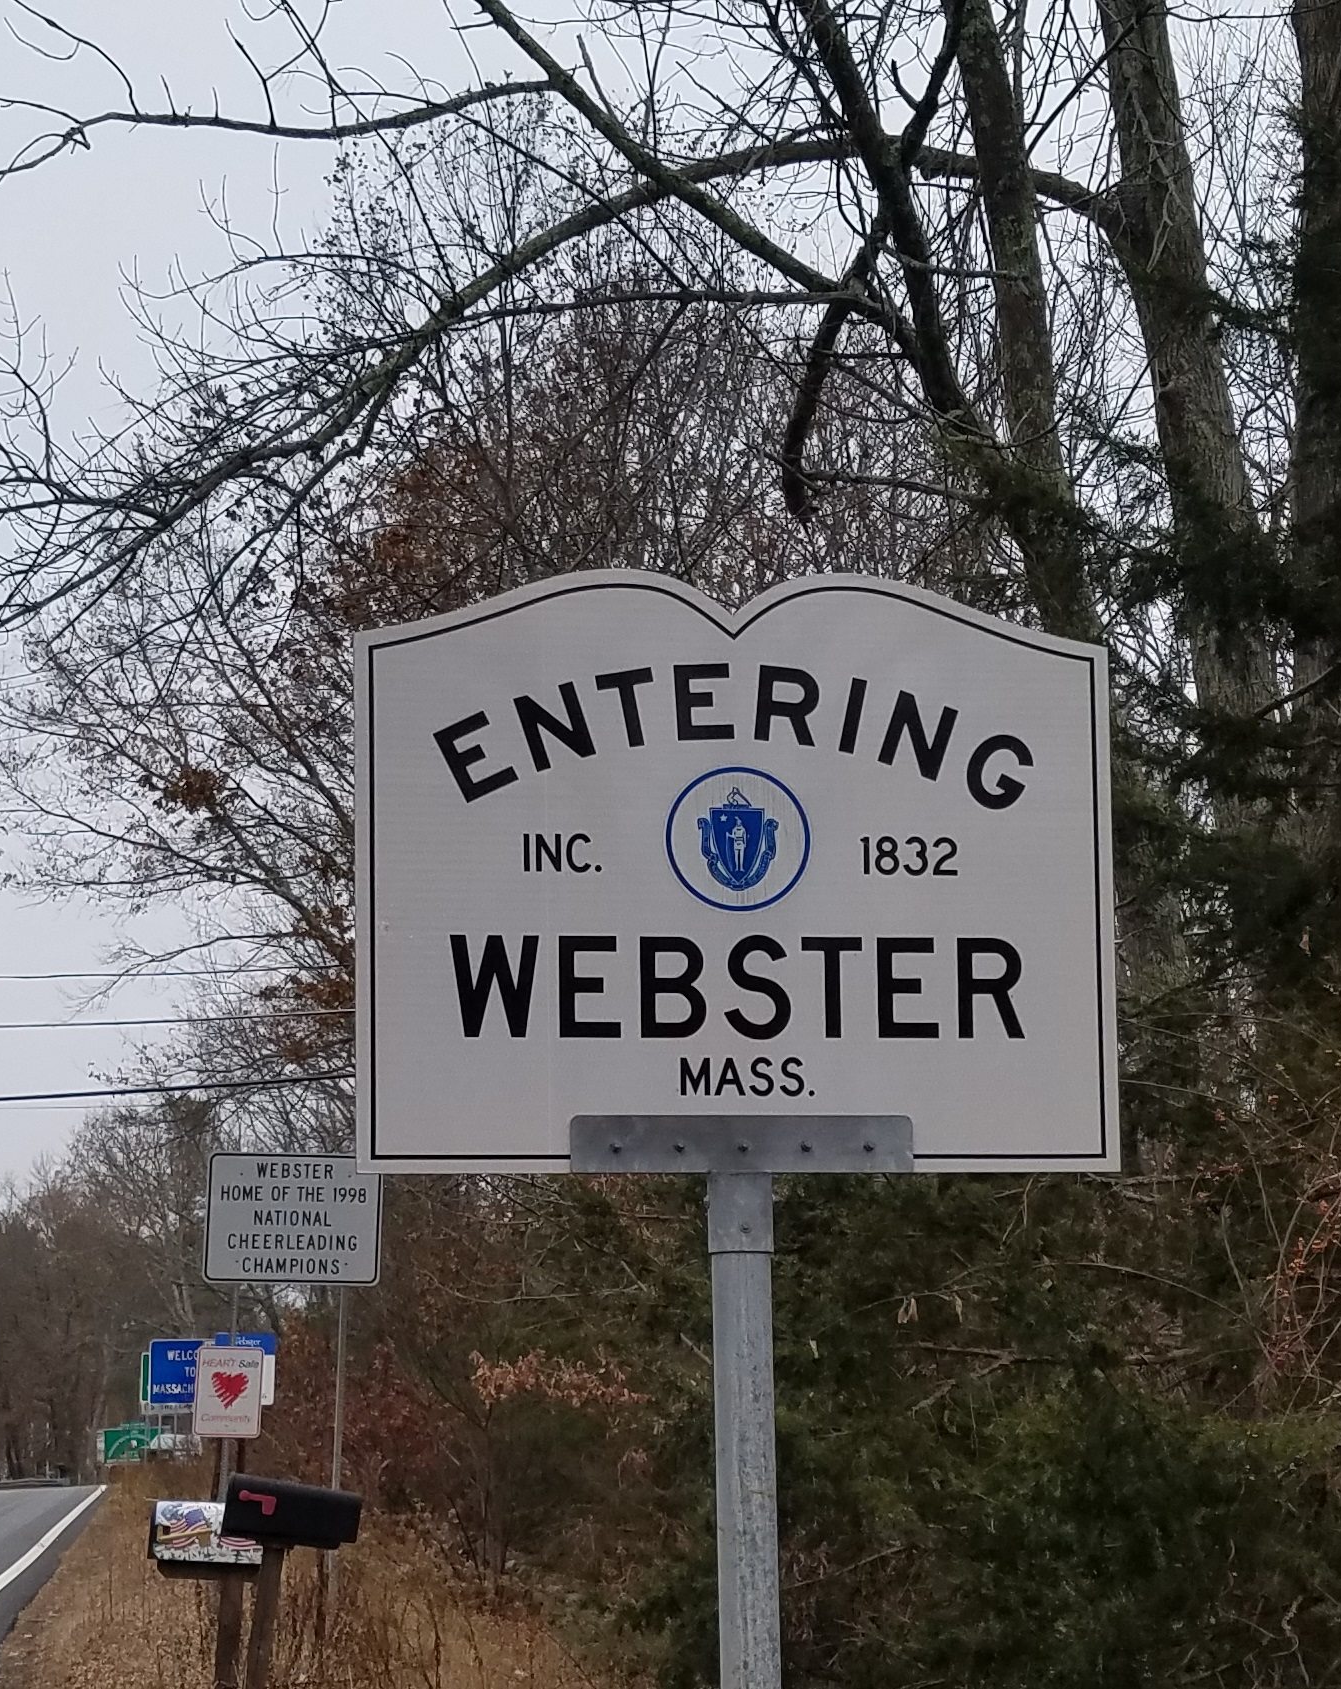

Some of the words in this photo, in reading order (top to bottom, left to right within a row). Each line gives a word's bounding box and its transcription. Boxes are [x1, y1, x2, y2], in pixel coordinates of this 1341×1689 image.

[432, 663, 1034, 810] ENTERING
[522, 833, 603, 874] INC.
[859, 835, 959, 877] 1832
[449, 934, 1026, 1041] WEBSTER
[679, 1056, 816, 1098] MASS.
[256, 1162, 334, 1180] WEBSTER
[220, 1184, 264, 1202] HOME
[271, 1185, 291, 1202] OF
[296, 1186, 325, 1203] THE
[333, 1187, 367, 1204] 1998
[253, 1209, 332, 1228] NATIONAL
[227, 1233, 357, 1252] CHEERLEADING
[242, 1256, 340, 1275] CHAMPIONS
[167, 1350, 198, 1361] WELCO
[201, 1357, 235, 1368] HEART
[184, 1366, 196, 1378] TO
[152, 1383, 194, 1394] MASSACH
